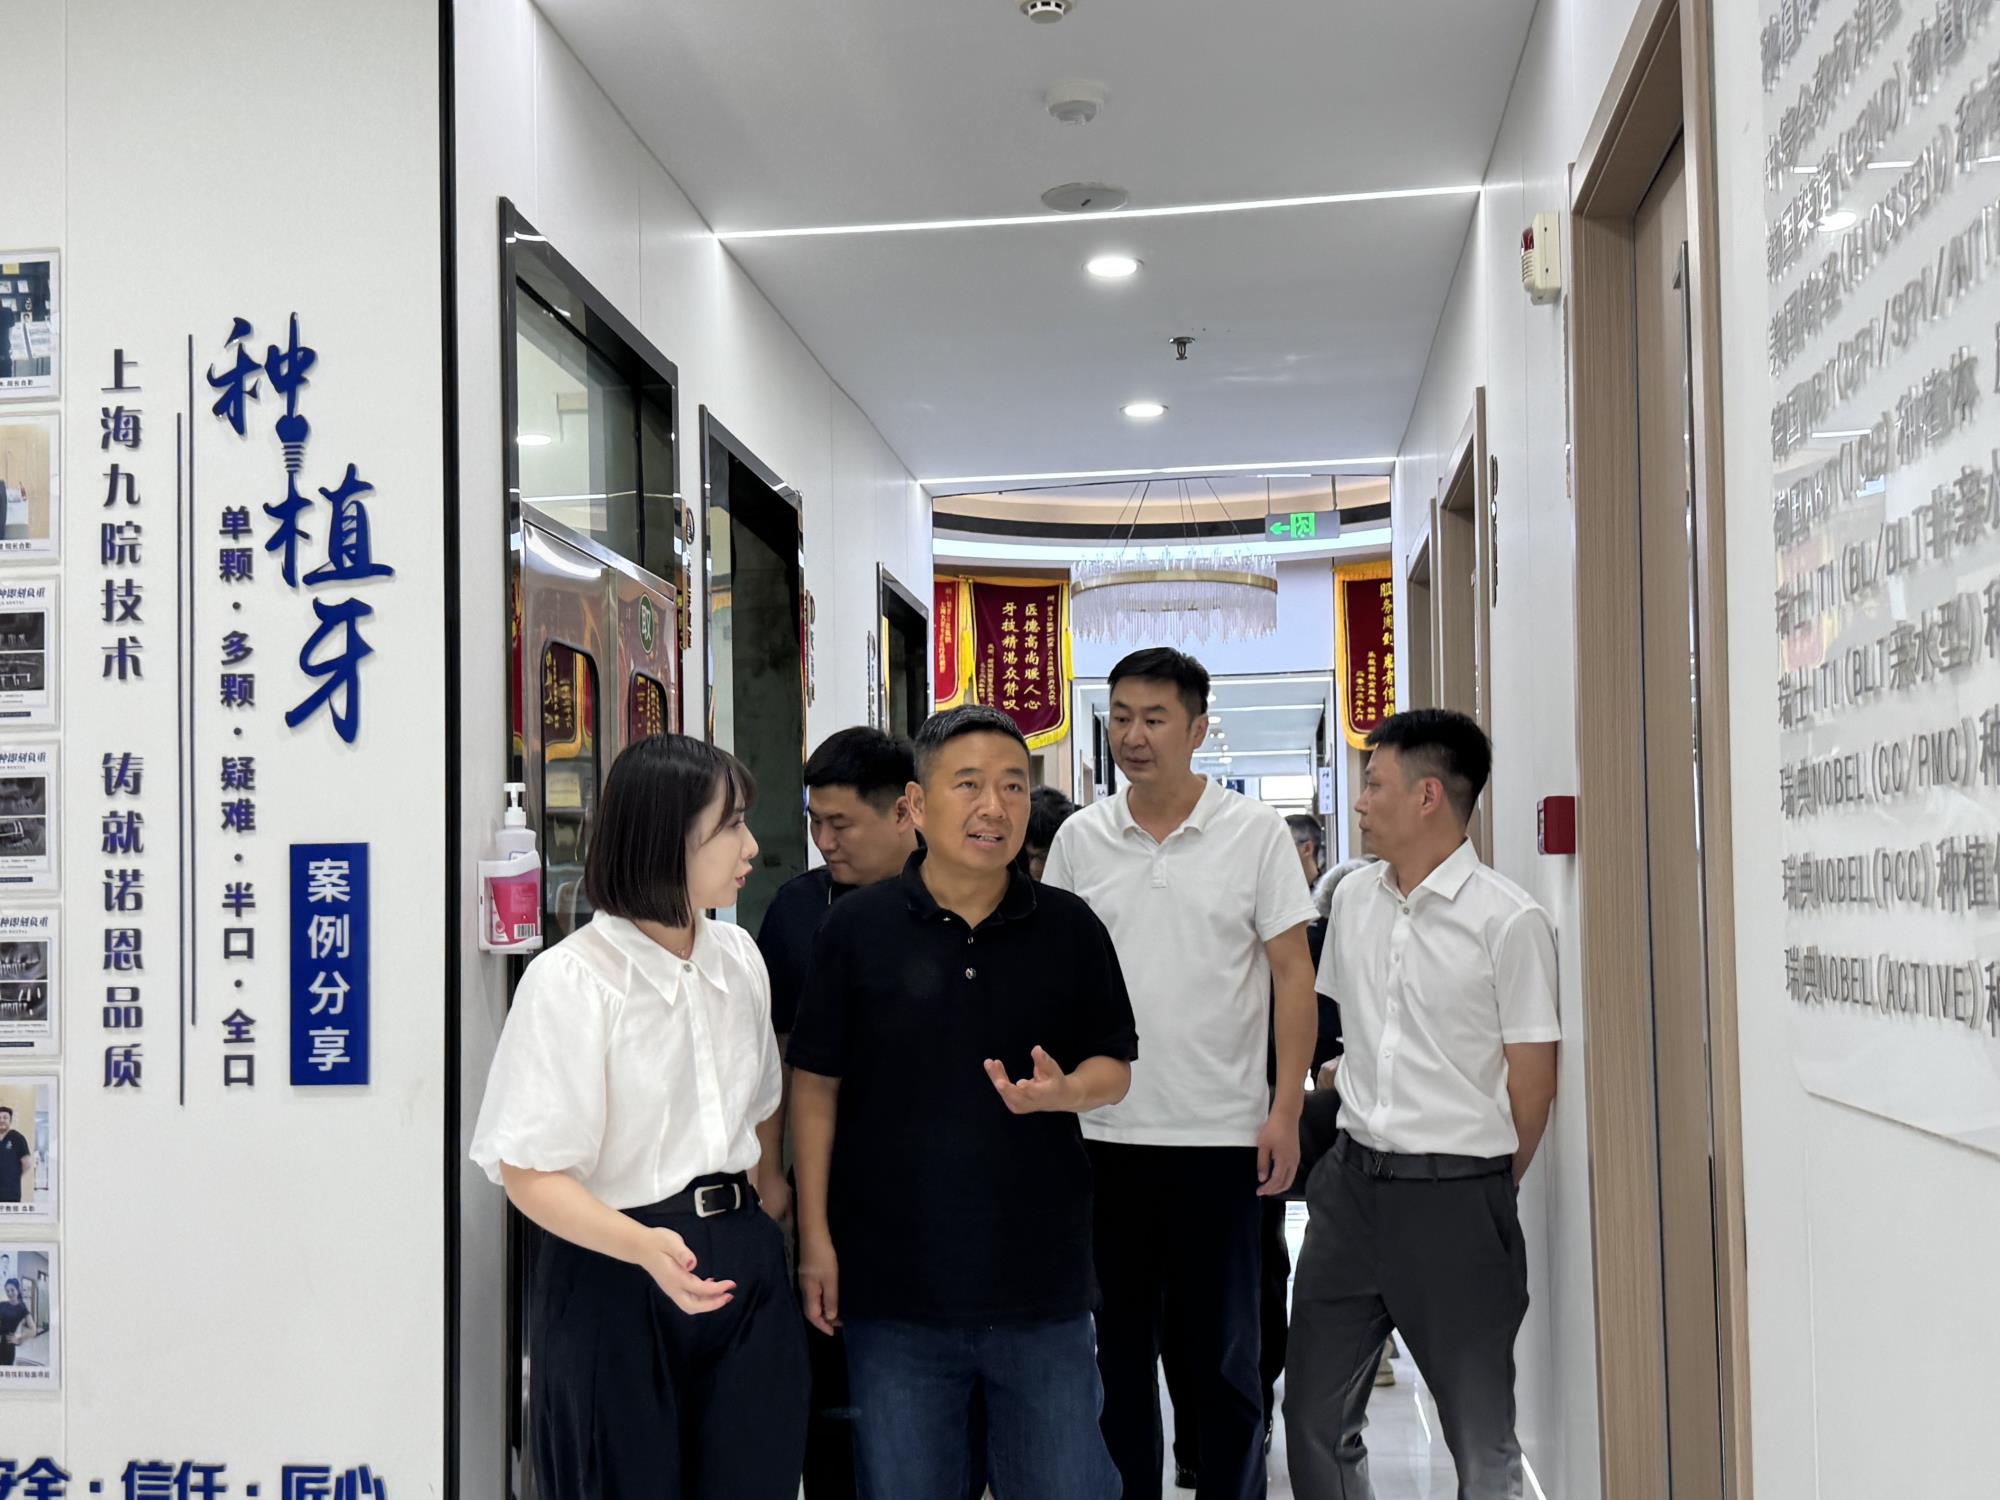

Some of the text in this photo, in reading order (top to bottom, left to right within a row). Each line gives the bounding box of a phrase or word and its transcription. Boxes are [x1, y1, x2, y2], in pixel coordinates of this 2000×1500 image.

[100, 348, 145, 1088] 上海九院技术 铸就诺恩品质
[206, 312, 396, 744] 种植牙
[307, 858, 351, 1072] 案例分享
